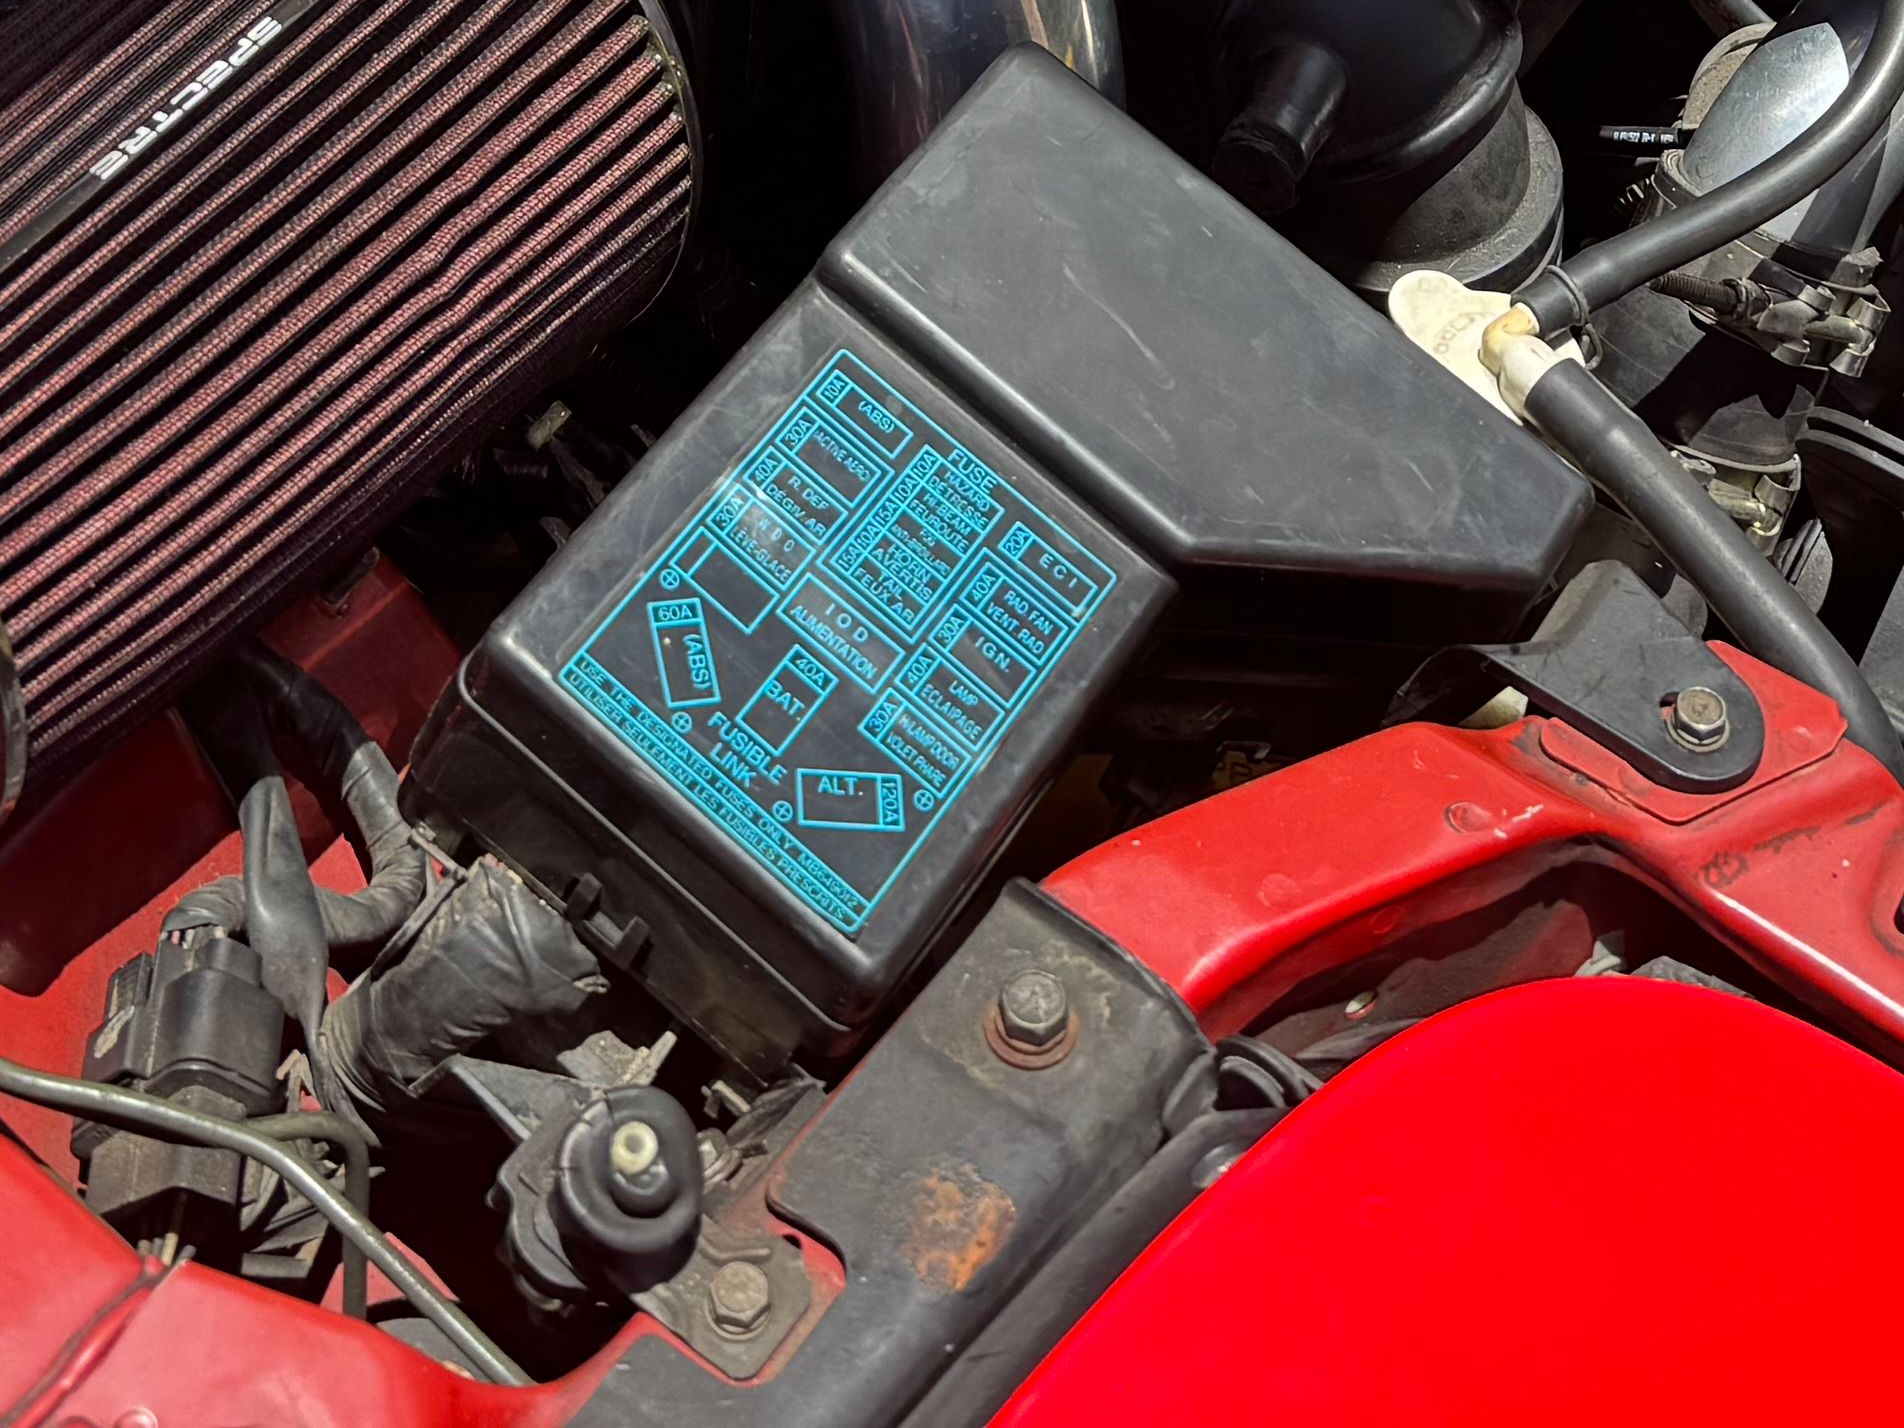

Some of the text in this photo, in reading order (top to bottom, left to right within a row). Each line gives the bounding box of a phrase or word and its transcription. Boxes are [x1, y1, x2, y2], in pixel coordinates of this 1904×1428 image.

[89, 16, 283, 181] SPECTRE
[823, 377, 894, 433] 10A (ABS)
[784, 418, 815, 449] 30A
[754, 456, 781, 486] 40A
[801, 487, 829, 509] DEF
[912, 448, 990, 511] 10A HAZARD
[946, 448, 997, 494] FUSE
[715, 492, 747, 526] 30A
[874, 500, 899, 525] 15A
[893, 476, 972, 536] 10A HI-BEAM
[853, 524, 931, 584] 10A HORN
[1004, 524, 1033, 558] 20A
[837, 545, 907, 600] 15A TAIL
[870, 547, 932, 600] AVERTIS
[970, 572, 996, 601] 40A
[657, 603, 696, 624] 60A
[682, 632, 710, 692] (ABS)
[789, 604, 877, 679] ALIMENTATION
[937, 615, 1010, 672] 30A IGN.
[795, 651, 825, 686] 40A
[906, 654, 978, 705] 40A LAMP
[580, 657, 608, 685] USE
[610, 683, 638, 711] THE
[636, 707, 716, 779] DESIGNATED
[714, 775, 759, 818] FUSES
[868, 700, 898, 731] 30A
[565, 672, 626, 726] UTILISER
[618, 717, 695, 784] SEULEMENT
[691, 781, 722, 809] LES
[715, 802, 780, 860] FUSIBLES
[707, 710, 787, 785] FUSIBLE
[709, 741, 757, 787] LINK
[883, 778, 901, 826] 120A
